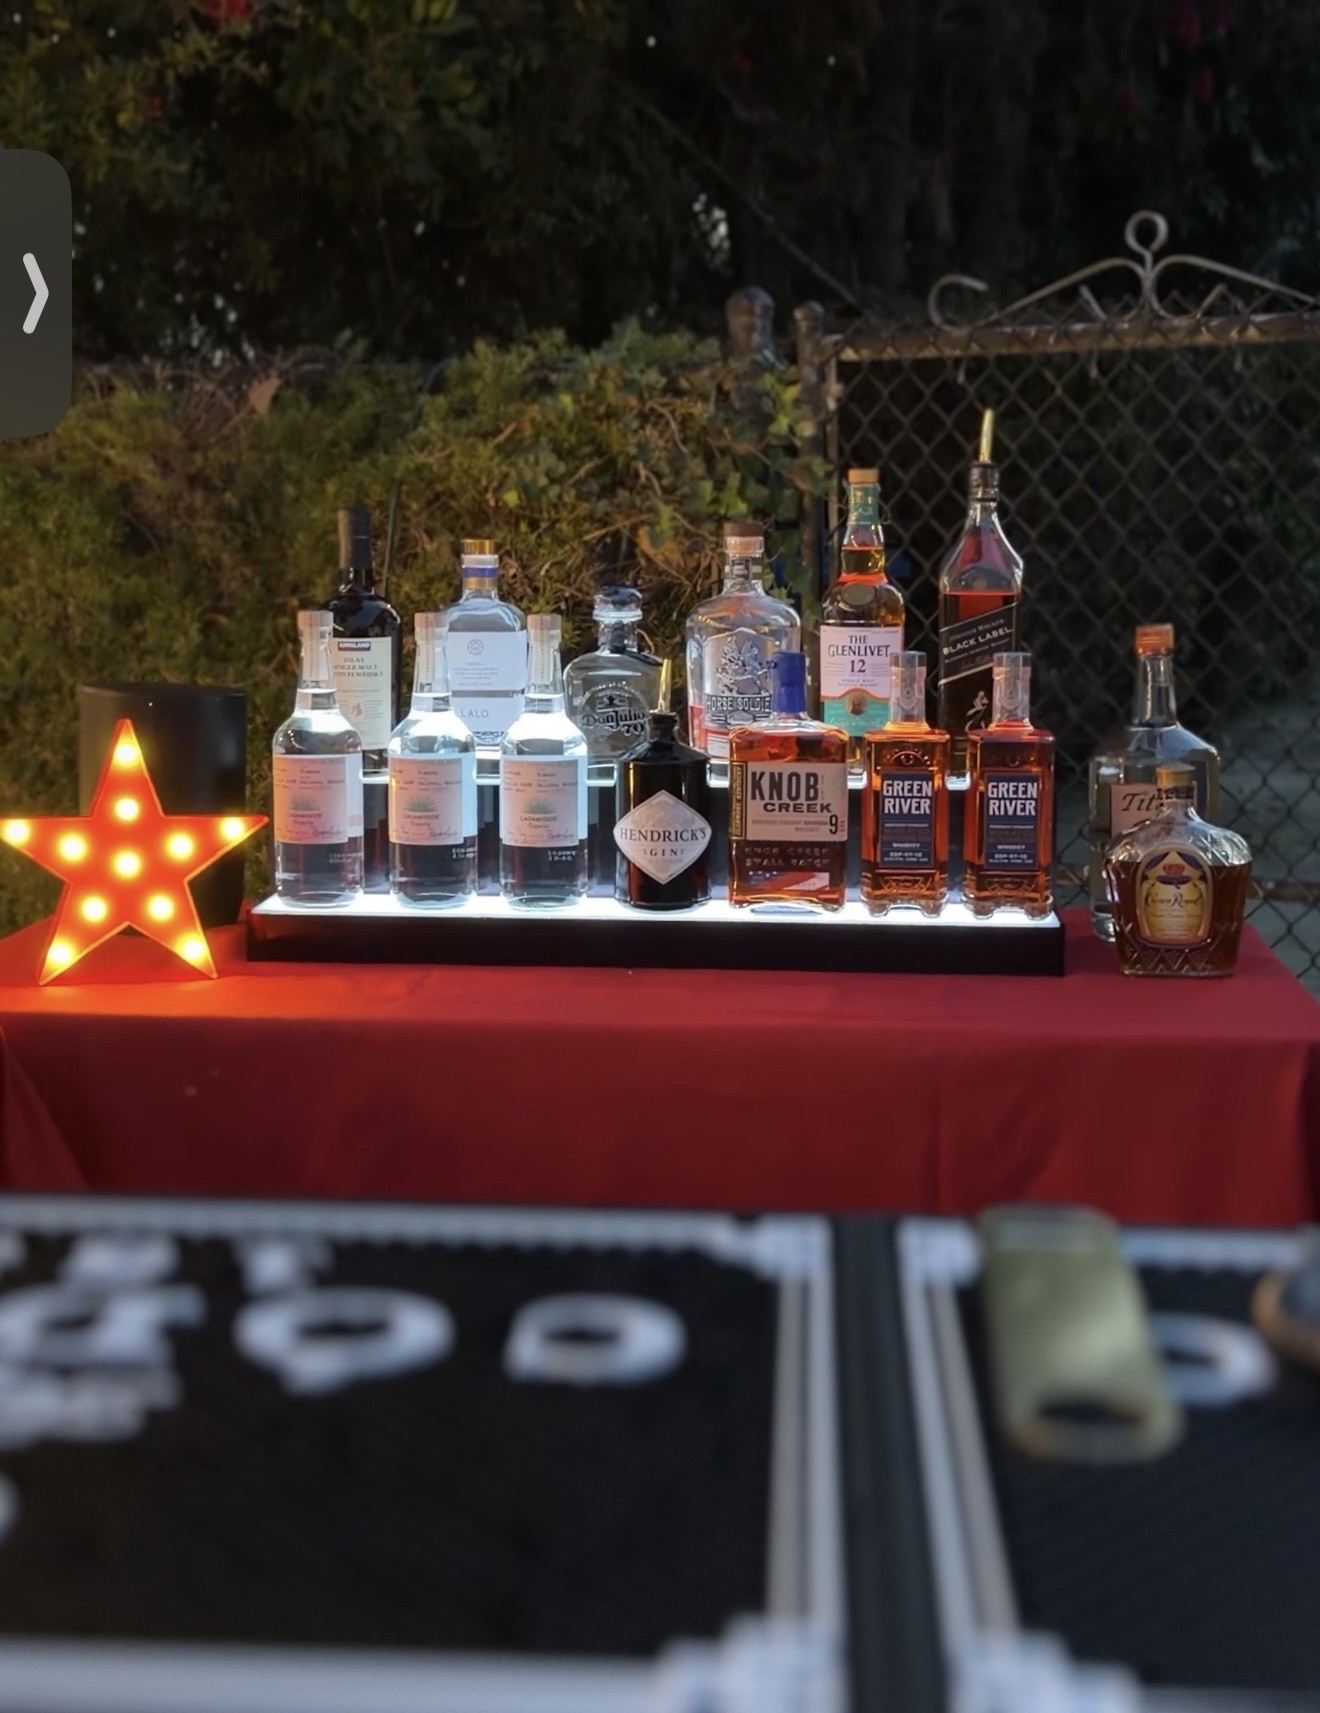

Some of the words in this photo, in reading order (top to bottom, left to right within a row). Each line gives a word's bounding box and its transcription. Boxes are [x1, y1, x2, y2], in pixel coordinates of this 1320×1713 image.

[849, 635, 868, 645] THE
[942, 637, 977, 656] BLACK
[978, 626, 1014, 643] LABEL
[828, 644, 890, 657] GLENLIVET
[850, 659, 867, 673] 12
[706, 696, 734, 711] HORSE
[737, 697, 773, 712] SOLDIE
[460, 709, 490, 718] LALO
[622, 721, 645, 736] 70
[751, 771, 819, 801] KNOB
[883, 780, 933, 797] GREEN
[987, 782, 1038, 799] GREEN
[763, 802, 833, 813] CREEK
[884, 798, 931, 815] RIVER
[989, 800, 1036, 816] RIVER
[829, 813, 839, 835] 9
[620, 827, 706, 843] HENDRICK'S
[649, 848, 679, 857] GIN
